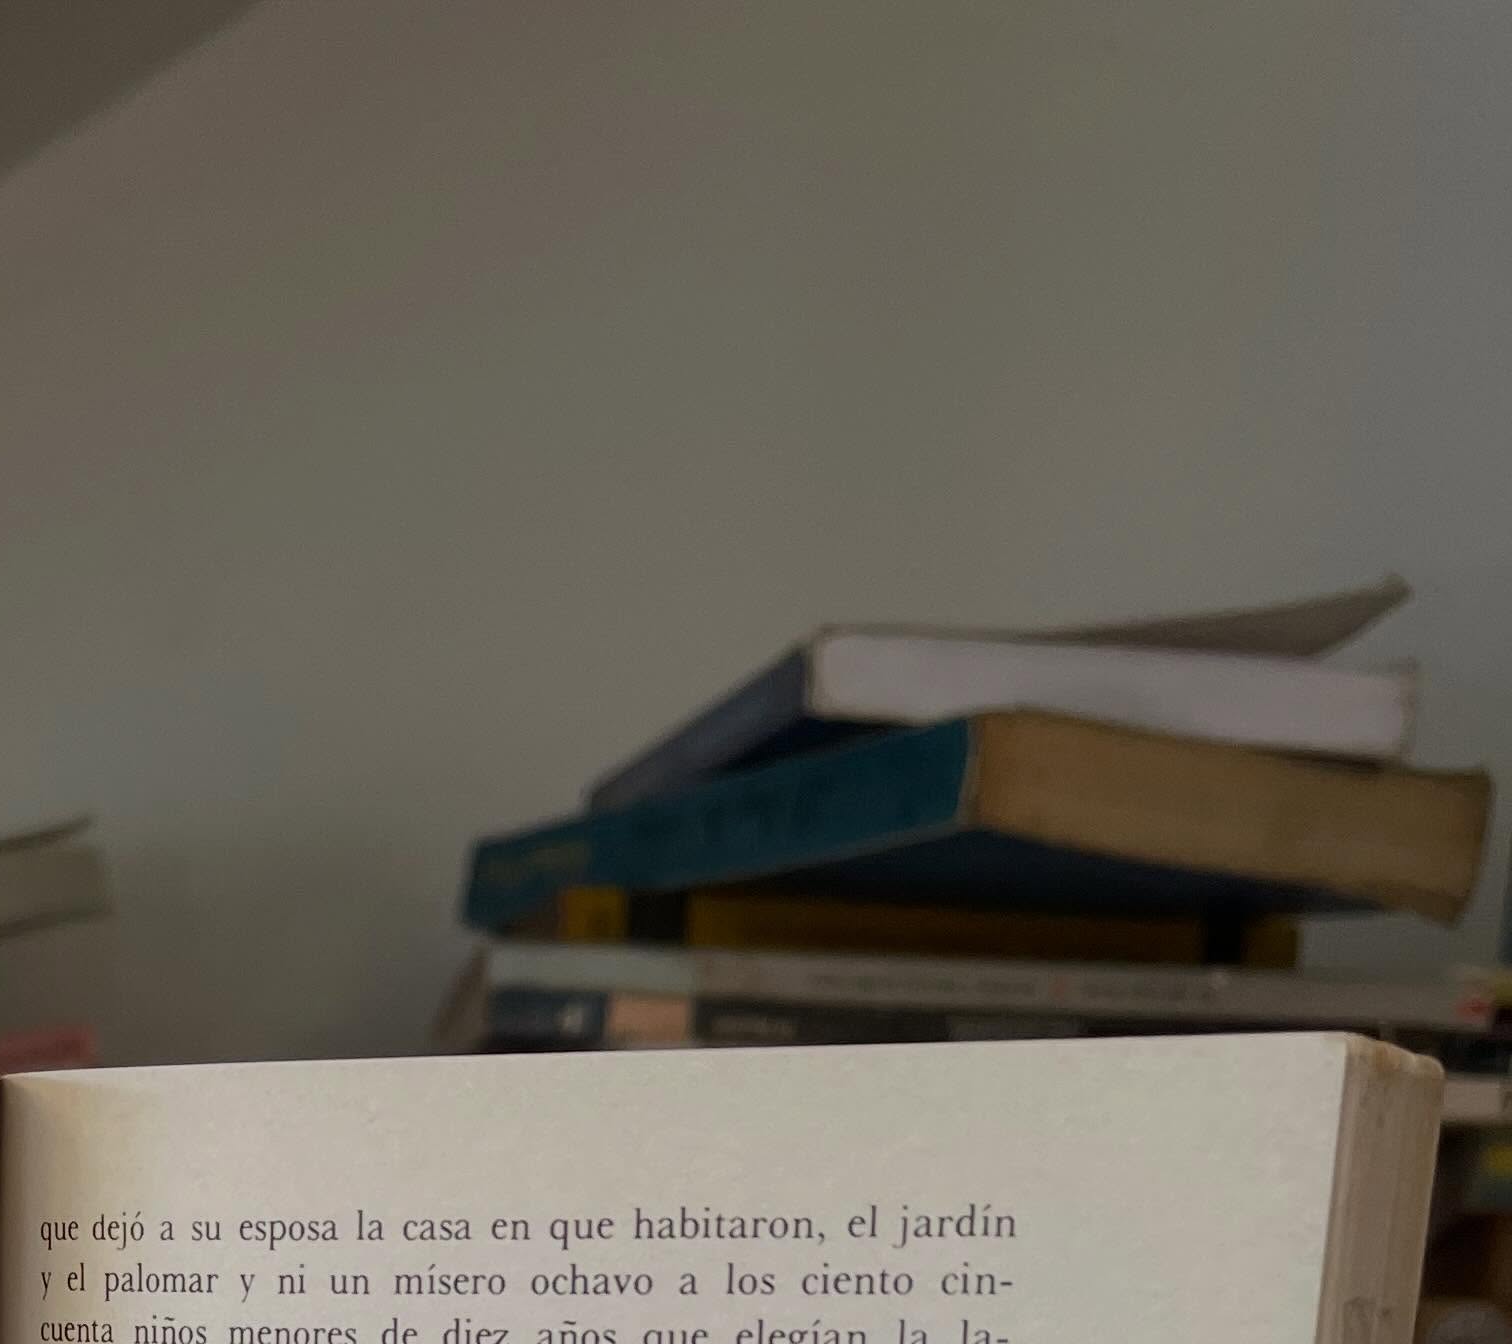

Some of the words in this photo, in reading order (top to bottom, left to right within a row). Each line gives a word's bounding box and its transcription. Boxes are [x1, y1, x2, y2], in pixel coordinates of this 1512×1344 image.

[40, 1220, 79, 1252] que
[92, 1210, 145, 1251] dejó
[159, 1220, 175, 1241] a
[191, 1220, 222, 1242] su
[239, 1219, 339, 1252] esposa
[356, 1209, 385, 1241] la
[402, 1219, 472, 1242] casa
[491, 1218, 531, 1241] en
[549, 1217, 615, 1251] que
[634, 1206, 825, 1244] habitaron,
[847, 1204, 878, 1239] el
[900, 1203, 1016, 1249] jardín
